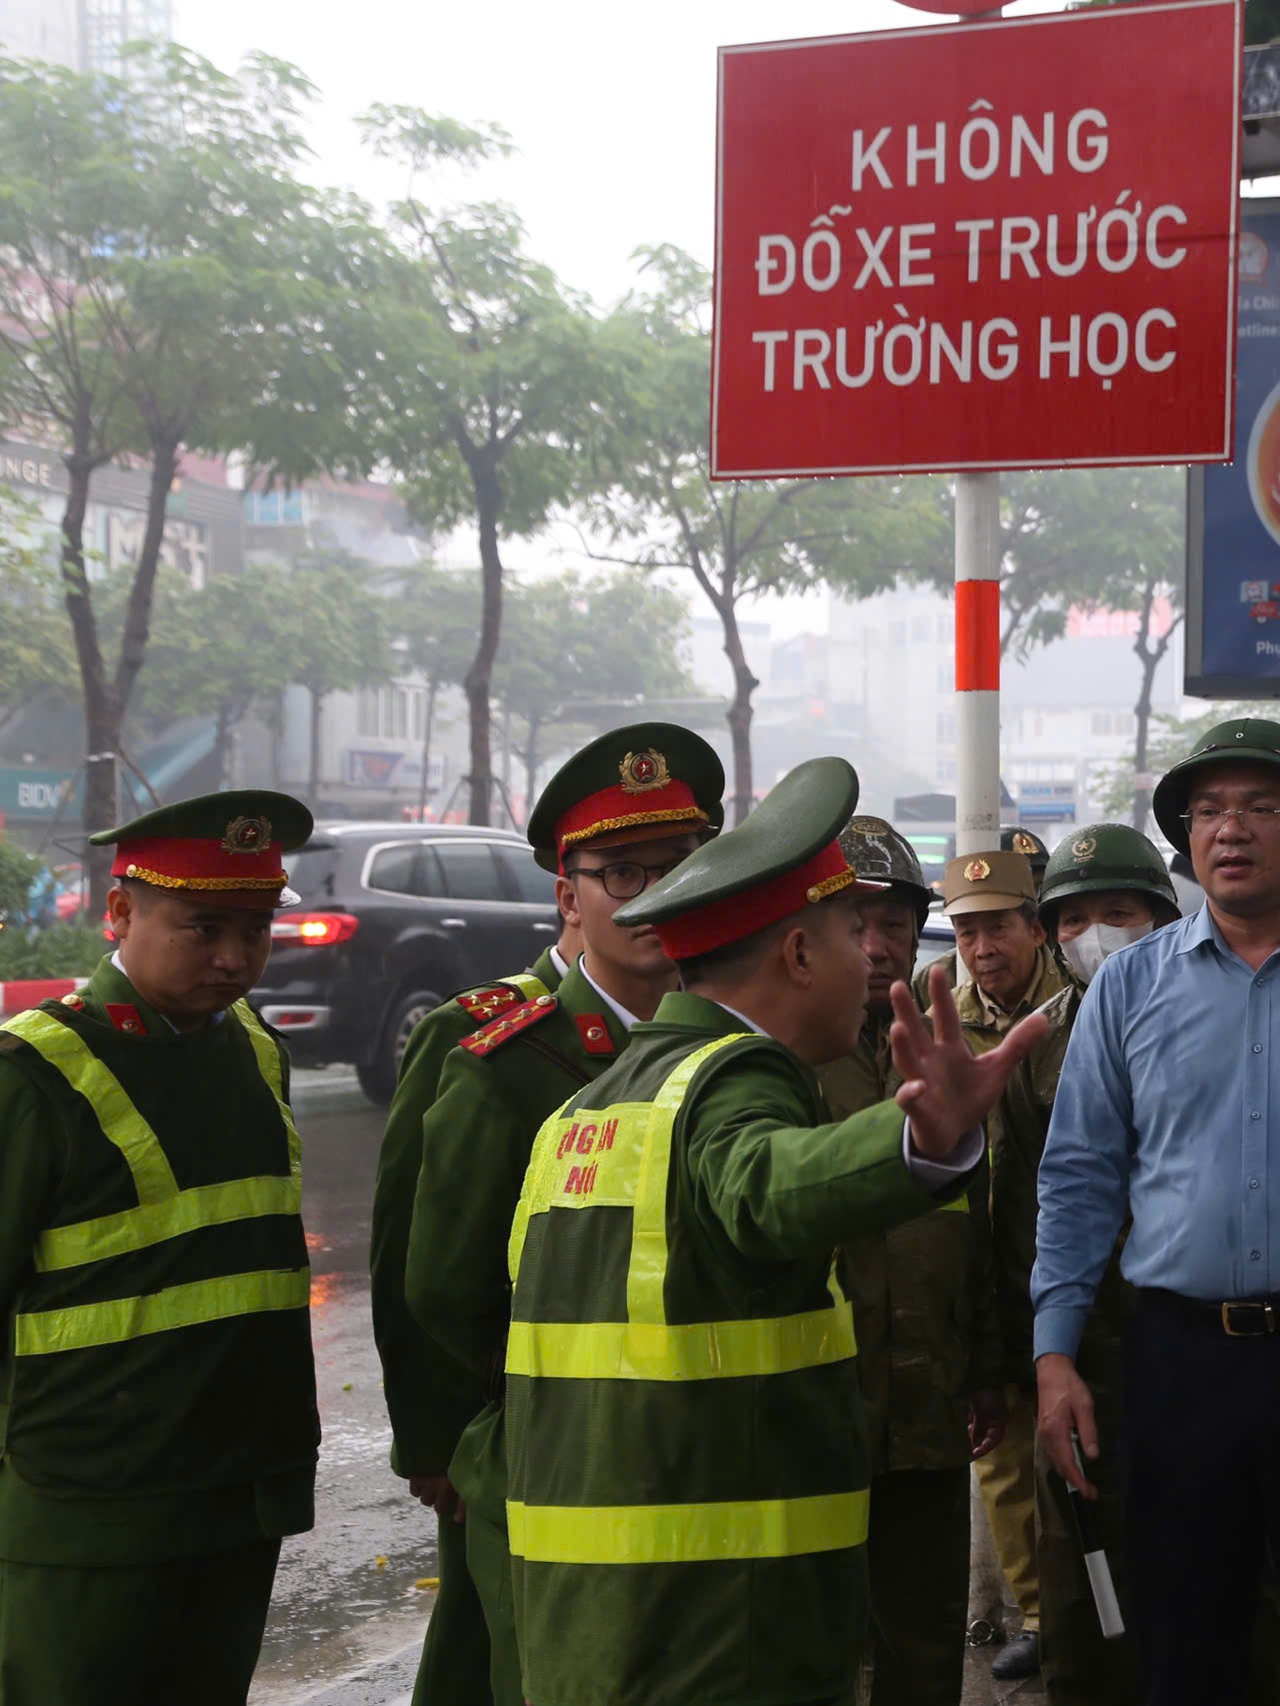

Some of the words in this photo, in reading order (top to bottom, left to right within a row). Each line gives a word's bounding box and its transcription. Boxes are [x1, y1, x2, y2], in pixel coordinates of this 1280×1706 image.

[851, 98, 1109, 191] KHÔNG
[755, 204, 852, 296] ĐỖ
[853, 221, 936, 290] XE
[956, 189, 1187, 283] TRƯỚC
[752, 303, 1019, 392] TRƯỜNG
[1039, 308, 1177, 390] HỌC
[1238, 320, 1280, 337] otline:
